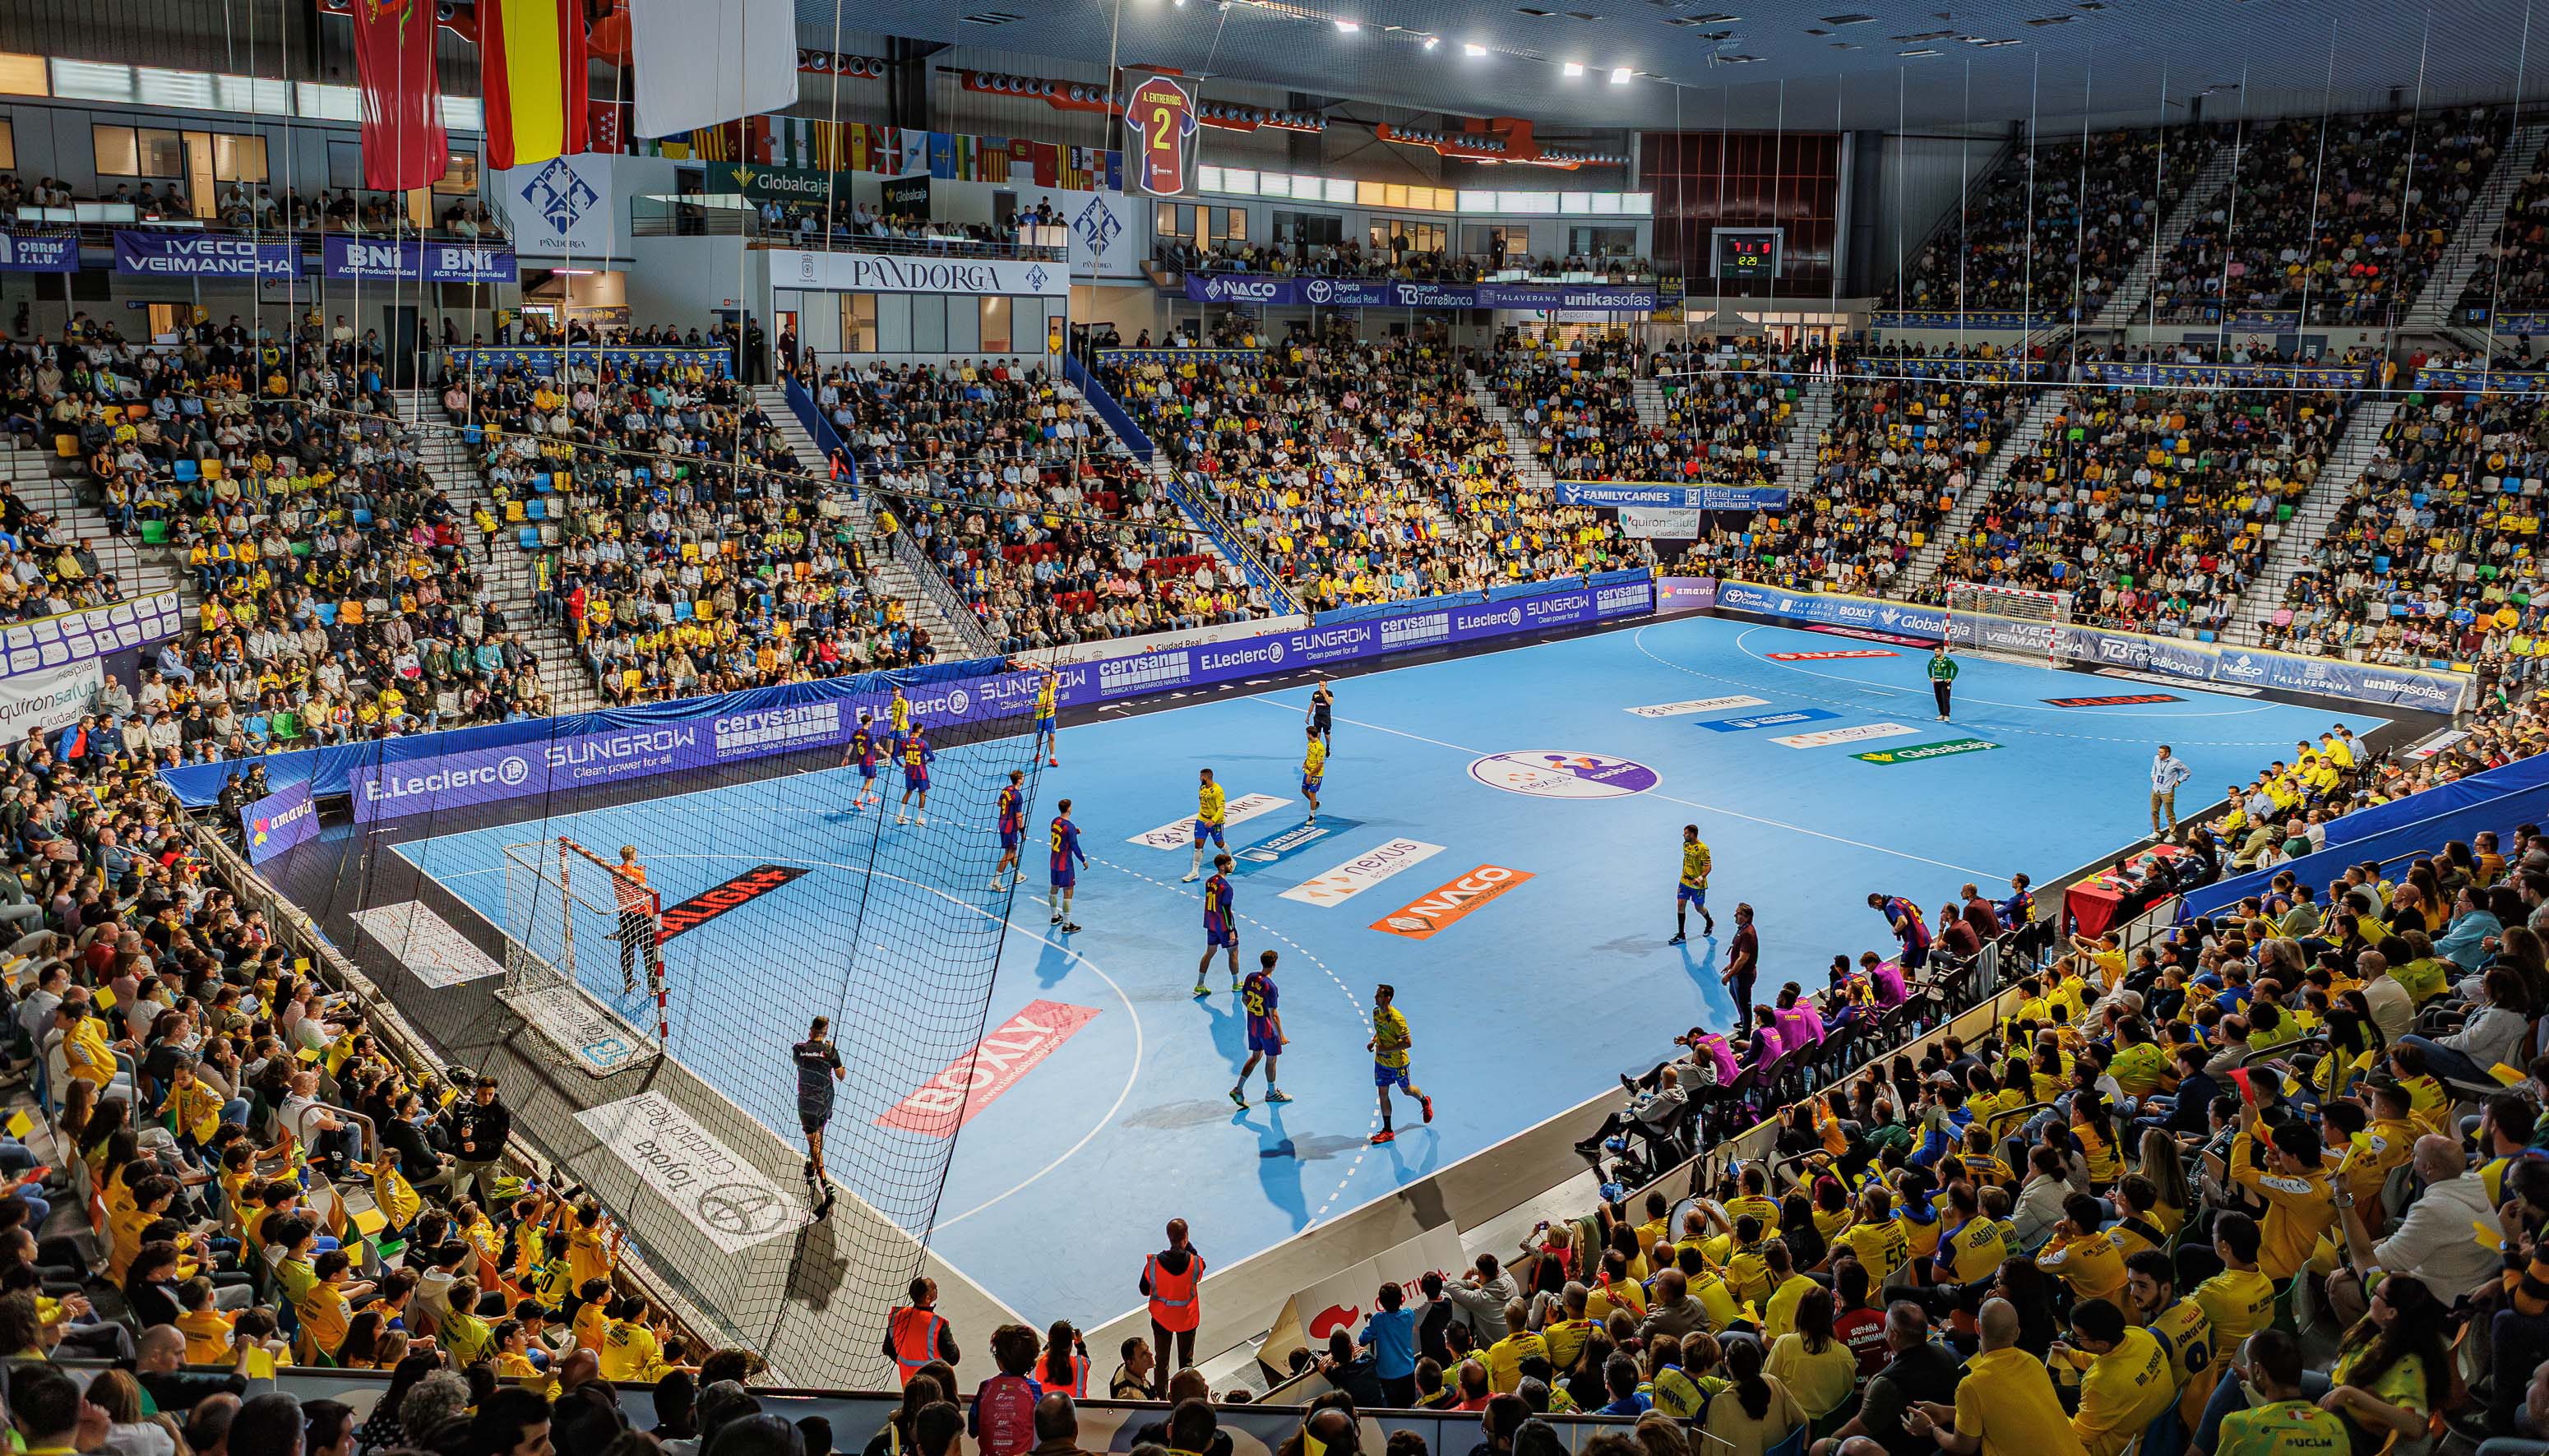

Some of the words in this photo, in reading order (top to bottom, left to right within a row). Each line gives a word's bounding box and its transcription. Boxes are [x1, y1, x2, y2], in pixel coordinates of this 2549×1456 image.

[1143, 92, 1149, 102] A.
[1149, 94, 1182, 106] ENTRERRÍOS
[1153, 108, 1171, 150] 2
[758, 173, 830, 197] Globalcaja
[895, 187, 927, 203] Globalcaja
[18, 243, 63, 254] OBRAS
[165, 240, 256, 256] IVECO
[346, 244, 402, 268] BNI
[20, 253, 58, 264] S.L.U.
[125, 256, 294, 273] VEIMANCHA
[442, 248, 492, 270] BNI
[359, 267, 416, 276] Productividad
[453, 270, 507, 279] Productividad
[853, 257, 1001, 291] PANDORGA
[1224, 282, 1276, 297] NACO
[1334, 282, 1360, 292] Toyota
[1334, 294, 1362, 303] Ciudad
[1363, 294, 1380, 303] Real
[1418, 294, 1473, 306] TorreBlanca
[1564, 293, 1651, 307] unikasofas
[1583, 490, 1670, 502] FAMILYCARNES
[1704, 489, 1731, 499] Hotel
[1703, 498, 1750, 509] Guadiana
[1668, 508, 1697, 517] Hospital
[1631, 517, 1697, 529] quirónsalud
[1679, 529, 1696, 538] Real
[1596, 585, 1637, 602] cerysan
[1676, 586, 1714, 598] amavir
[1743, 591, 1763, 600] Toyota
[1527, 594, 1589, 615] SUNGROW
[1741, 598, 1761, 608] Ciudad
[1553, 615, 1566, 625] power
[1839, 606, 1876, 618] BOXLY
[1381, 615, 1434, 634] cerysan
[1457, 613, 1508, 631] E.Leclerc
[1292, 626, 1370, 652] SUNGROW
[2010, 624, 2066, 639] IVECO
[1156, 642, 1179, 653] Ciudad
[1181, 638, 1201, 648] Real
[1406, 638, 1429, 646] SANITARIOS
[2129, 642, 2156, 654] GRUPO
[1067, 655, 1085, 663] Real
[1201, 649, 1266, 670] E.Leclerc
[1307, 650, 1325, 660] Clean
[1325, 649, 1341, 659] power
[1350, 645, 1358, 654] all
[1800, 650, 1892, 659] NACO
[55, 659, 96, 681] Hospital
[1099, 653, 1169, 677] cerysan
[2222, 663, 2263, 676] NACO
[980, 669, 1085, 700] SUNGOW
[1133, 680, 1163, 691] SANITARIOS
[2272, 674, 2352, 692] TALAVERANA
[2362, 677, 2448, 700] unikasofas
[0, 677, 98, 725] quirónsalud
[1000, 700, 1018, 710] Clean
[39, 708, 76, 728] Ciudad
[856, 698, 946, 723] ELelerc
[714, 704, 806, 734] cerysan
[544, 727, 695, 768] SUNGROW
[1897, 742, 1996, 760] Globalcaja
[905, 751, 921, 765] 45
[574, 767, 605, 779] Clean
[608, 761, 641, 777] power
[643, 757, 655, 768] for
[656, 754, 672, 765] all
[367, 764, 496, 802] E.Leclerc
[1520, 775, 1572, 791] nexus
[271, 797, 313, 829] amavir
[1261, 825, 1316, 848] LOTERÍAS
[1344, 843, 1418, 876] nexus
[1409, 867, 1513, 918] NACO
[661, 870, 788, 939] ALIGA+
[1247, 990, 1264, 1016] 23
[903, 1015, 1056, 1114] BOXLY
[976, 1033, 1066, 1102] www.tiendaboxly.com
[624, 1096, 673, 1126] Real
[673, 1120, 737, 1176] Ciudad
[633, 1139, 698, 1193] Toyota
[1850, 1323, 1880, 1336] ESPAÑA
